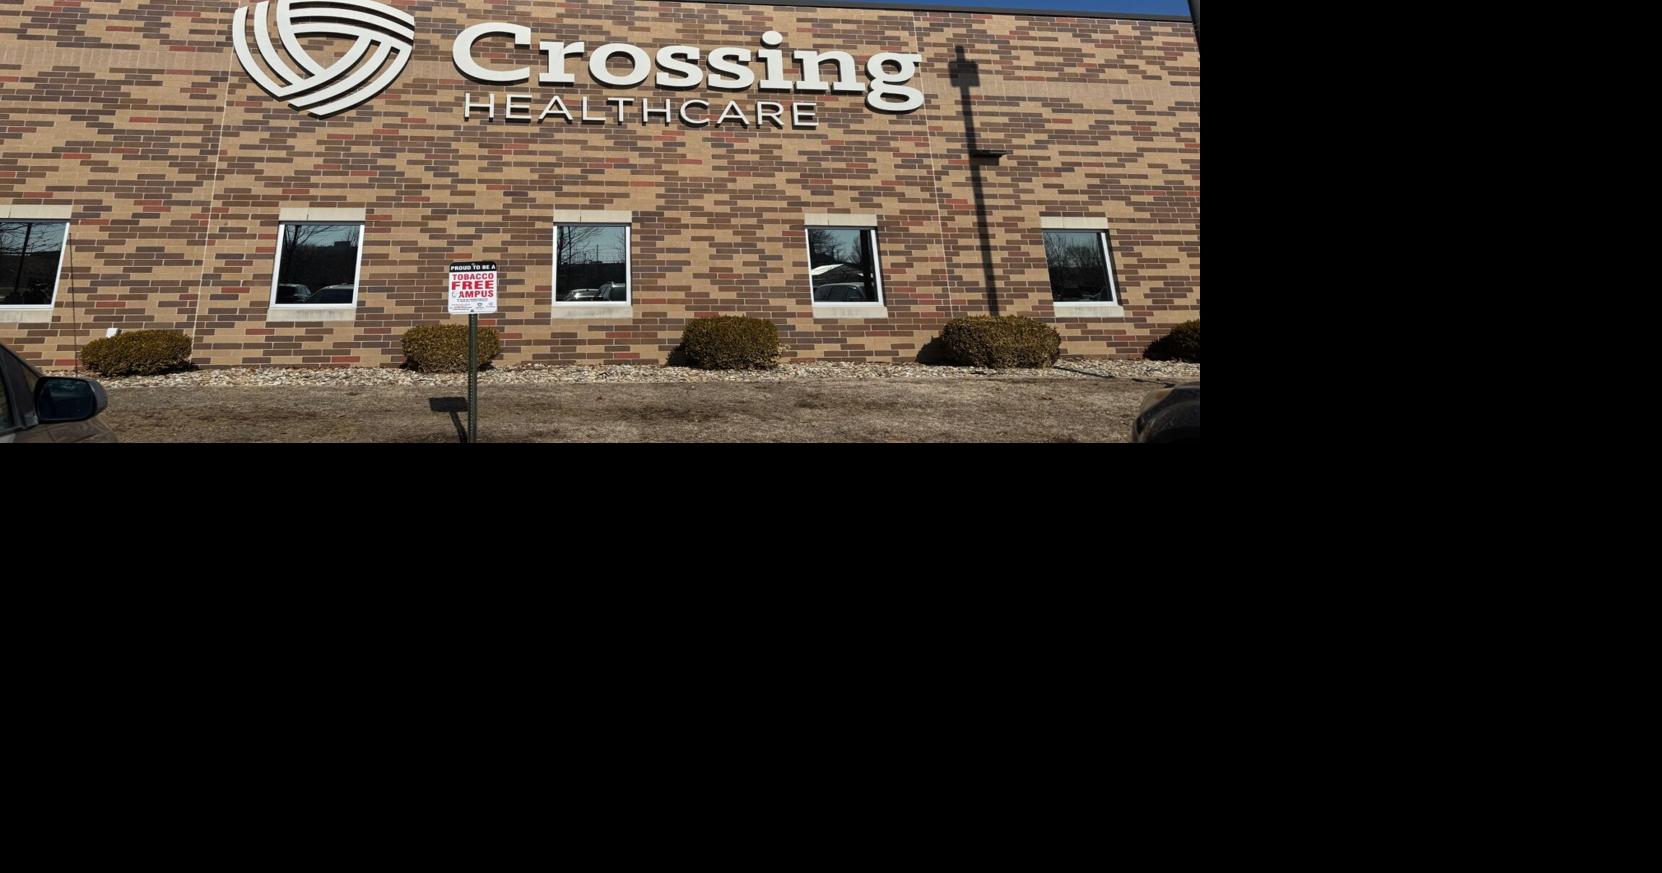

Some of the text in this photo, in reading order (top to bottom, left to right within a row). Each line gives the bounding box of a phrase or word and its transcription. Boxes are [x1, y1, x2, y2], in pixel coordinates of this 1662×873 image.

[452, 22, 925, 111] Crossing
[463, 92, 820, 127] HEALTHCARE
[451, 280, 494, 290] FREE
